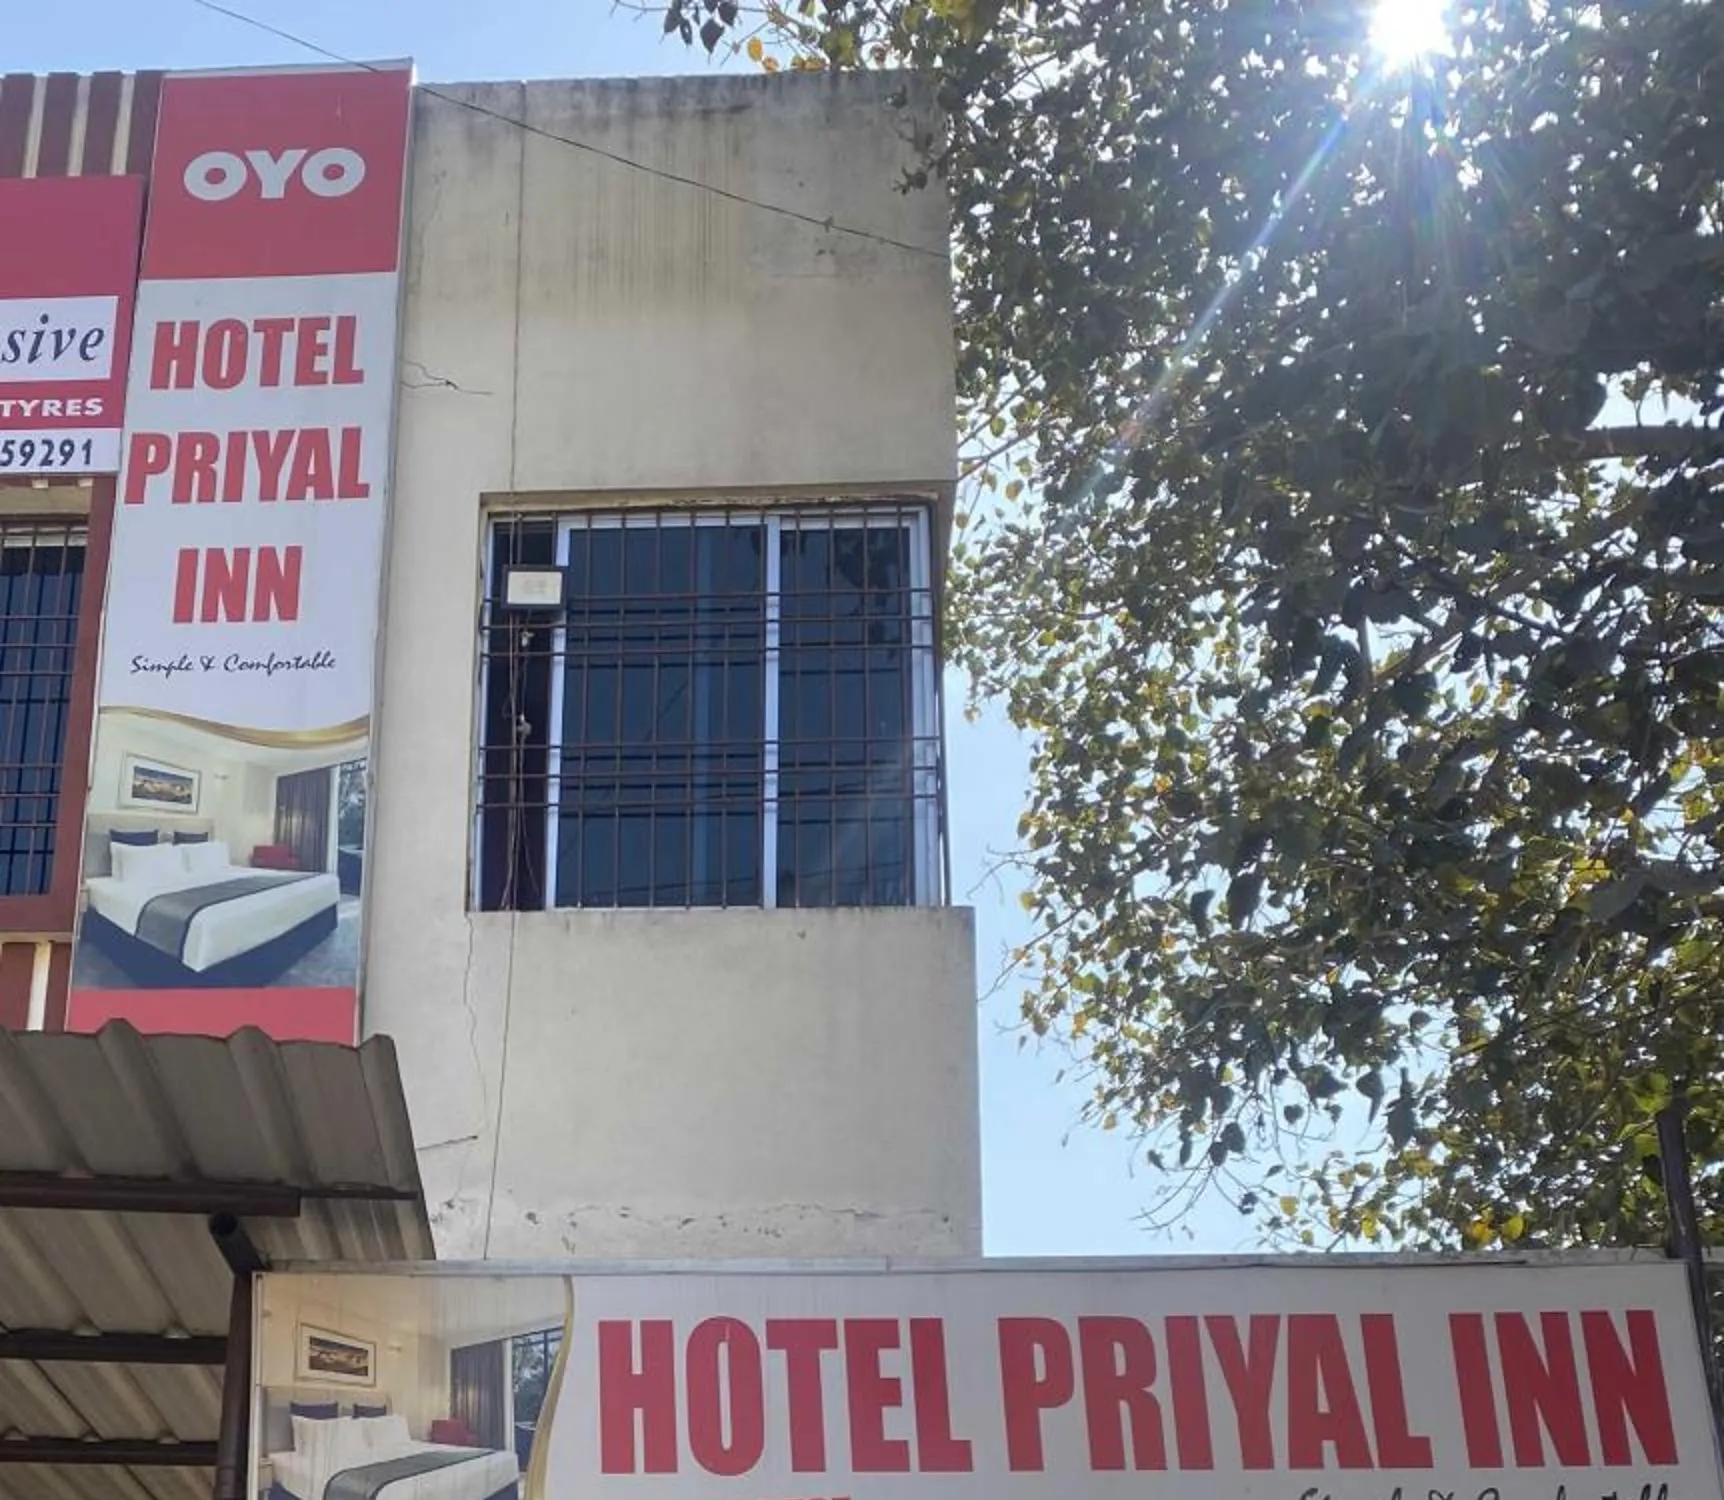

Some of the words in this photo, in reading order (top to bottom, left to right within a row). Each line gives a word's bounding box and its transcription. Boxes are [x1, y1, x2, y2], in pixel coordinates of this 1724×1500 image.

[183, 148, 366, 202] OYO
[1, 313, 105, 364] sive
[150, 316, 364, 390] HOTEL
[0, 397, 104, 418] TYRES
[124, 427, 369, 503] PRIYAL
[173, 546, 303, 623] INN
[130, 653, 194, 679] Simple
[200, 655, 216, 672] &
[224, 650, 337, 677] Comfortable
[599, 1315, 974, 1477] HOTEL
[997, 1312, 1435, 1473] PRIYAL
[1448, 1309, 1680, 1470] INN
